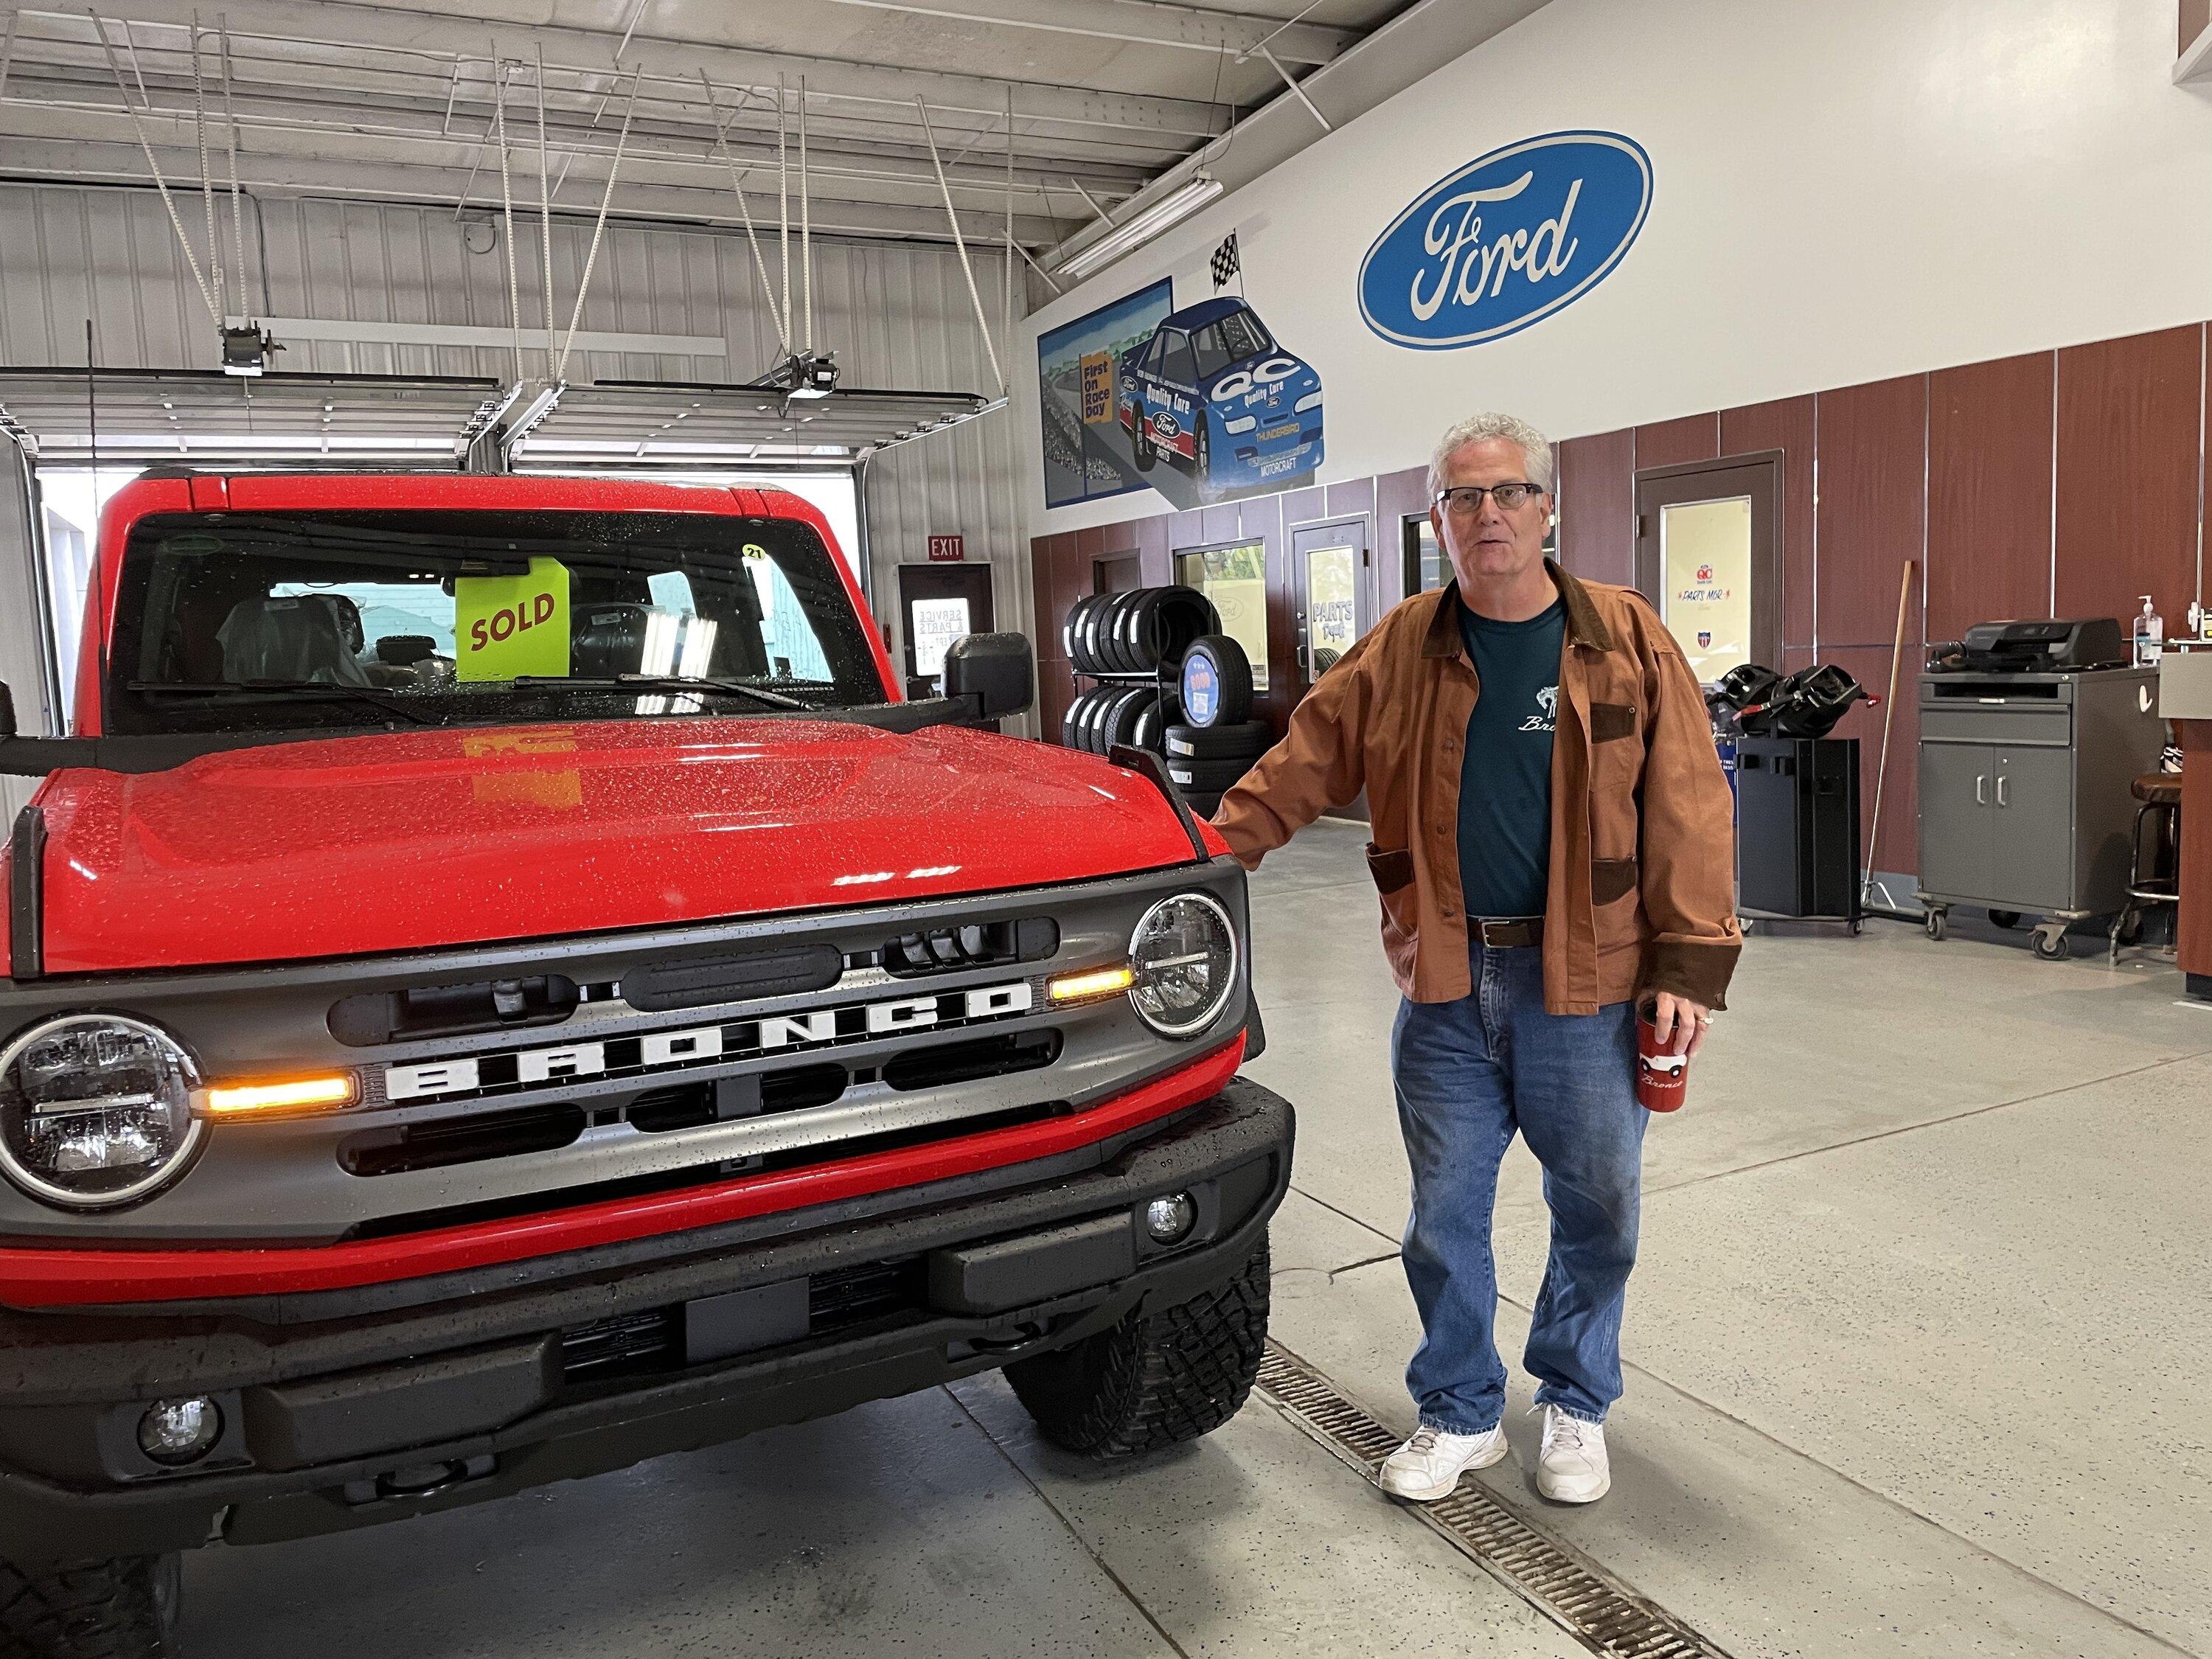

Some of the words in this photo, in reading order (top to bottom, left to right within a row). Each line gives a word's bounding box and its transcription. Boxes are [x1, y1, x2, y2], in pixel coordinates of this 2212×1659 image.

[1411, 170, 1583, 321] Ford
[1085, 361, 1108, 380] First
[1211, 358, 1301, 402] QC
[1085, 388, 1110, 406] Race
[1147, 383, 1172, 411] Quality
[1174, 393, 1190, 415] Care
[1245, 389, 1267, 408] Quality
[1269, 380, 1284, 395] Care
[1085, 402, 1105, 419] Day
[1156, 414, 1176, 435] Ford
[1261, 457, 1296, 478] MOTORCRAFT
[747, 548, 762, 560] 21
[931, 539, 960, 556] EXIT
[1697, 568, 1713, 580] QC
[1682, 591, 1705, 601] PARTS
[1217, 600, 1237, 617] Ford
[1312, 600, 1353, 622] PARTS
[470, 593, 554, 652] SOLD
[384, 982, 1032, 1101] BRONCO
[1641, 1074, 1683, 1088] Bronco
